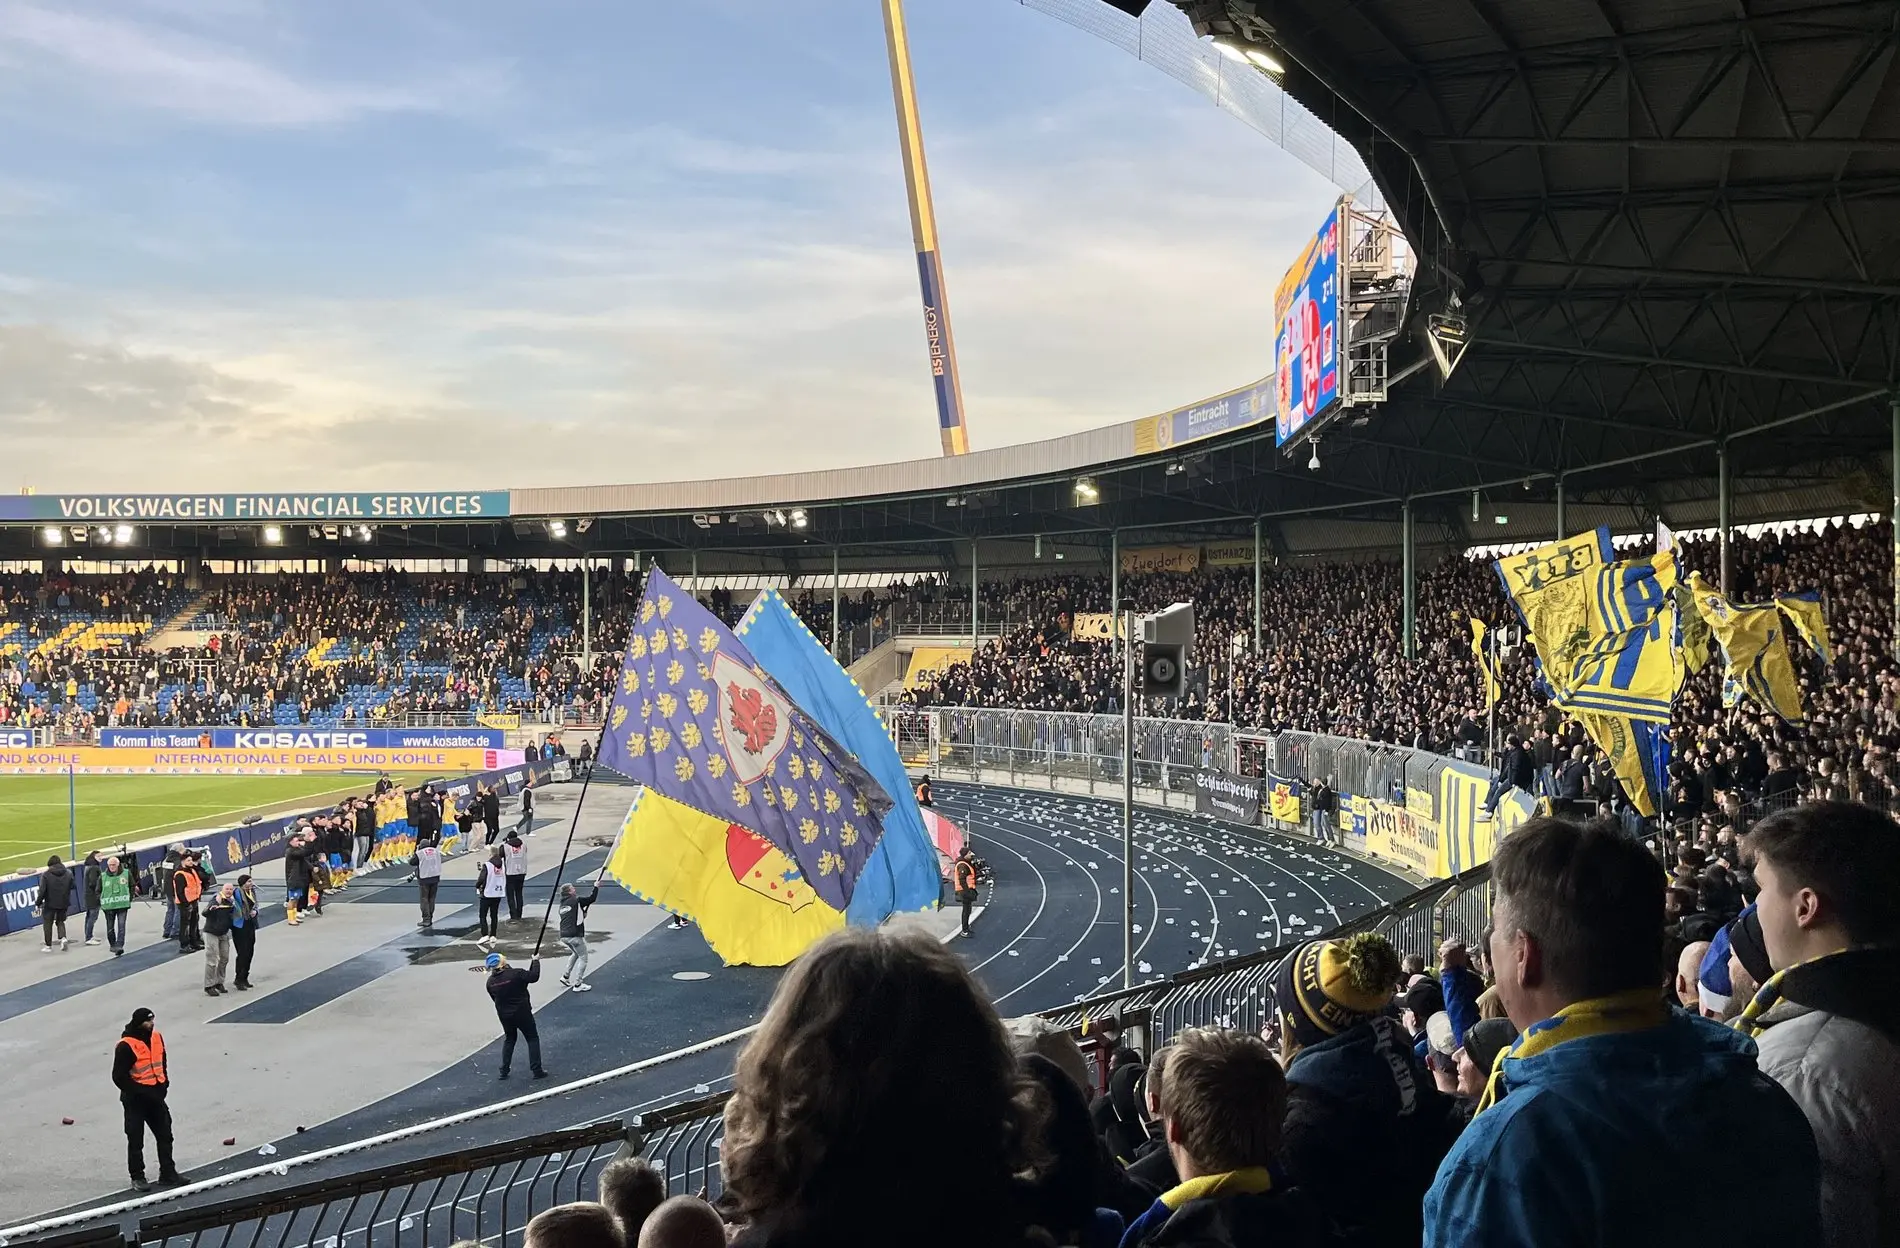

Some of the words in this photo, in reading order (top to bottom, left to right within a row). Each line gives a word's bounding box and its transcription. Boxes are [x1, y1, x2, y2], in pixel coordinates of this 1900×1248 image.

[1188, 401, 1230, 426] Eintracht
[60, 498, 225, 517] VOLKSWAGEN
[235, 497, 363, 516] FINANCIAL
[371, 495, 482, 515] SERVICES
[113, 735, 148, 747] Komm
[150, 735, 167, 747] ins
[235, 732, 367, 748] KOSATEC
[402, 735, 490, 747] www.kosatec.de
[27, 753, 80, 764] KOHLE
[155, 753, 289, 765] INTERNATIONALE
[295, 753, 347, 764] DEALS
[352, 754, 386, 764] UND
[392, 753, 446, 764] KOHLE
